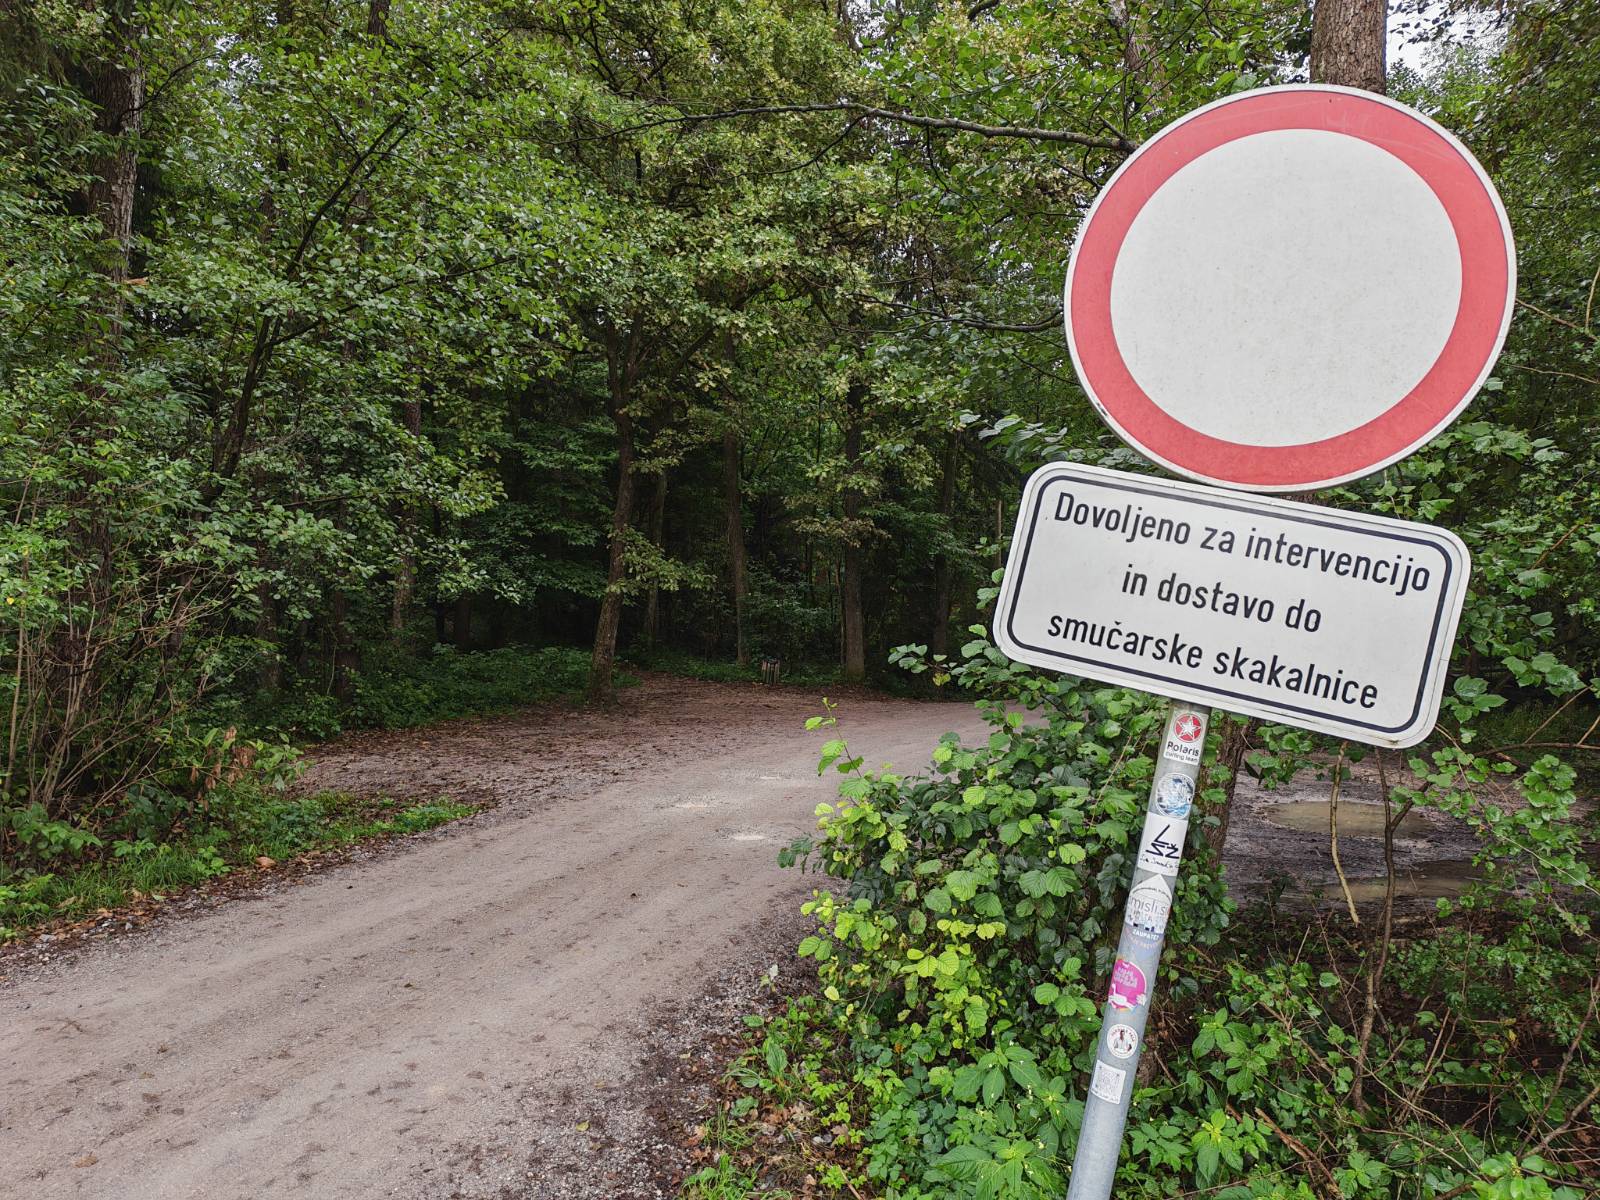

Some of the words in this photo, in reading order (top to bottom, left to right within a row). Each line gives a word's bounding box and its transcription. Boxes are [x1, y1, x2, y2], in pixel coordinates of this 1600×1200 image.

[1054, 491, 1191, 545] Dovoljeno
[1200, 527, 1235, 554] za
[1245, 527, 1430, 596] intervencijo
[1121, 563, 1148, 597] in
[1157, 572, 1275, 623] dostavo
[1285, 598, 1322, 633] do
[1047, 615, 1203, 669] smučarske
[1212, 646, 1378, 709] skakalnice
[1166, 740, 1200, 757] Polaris
